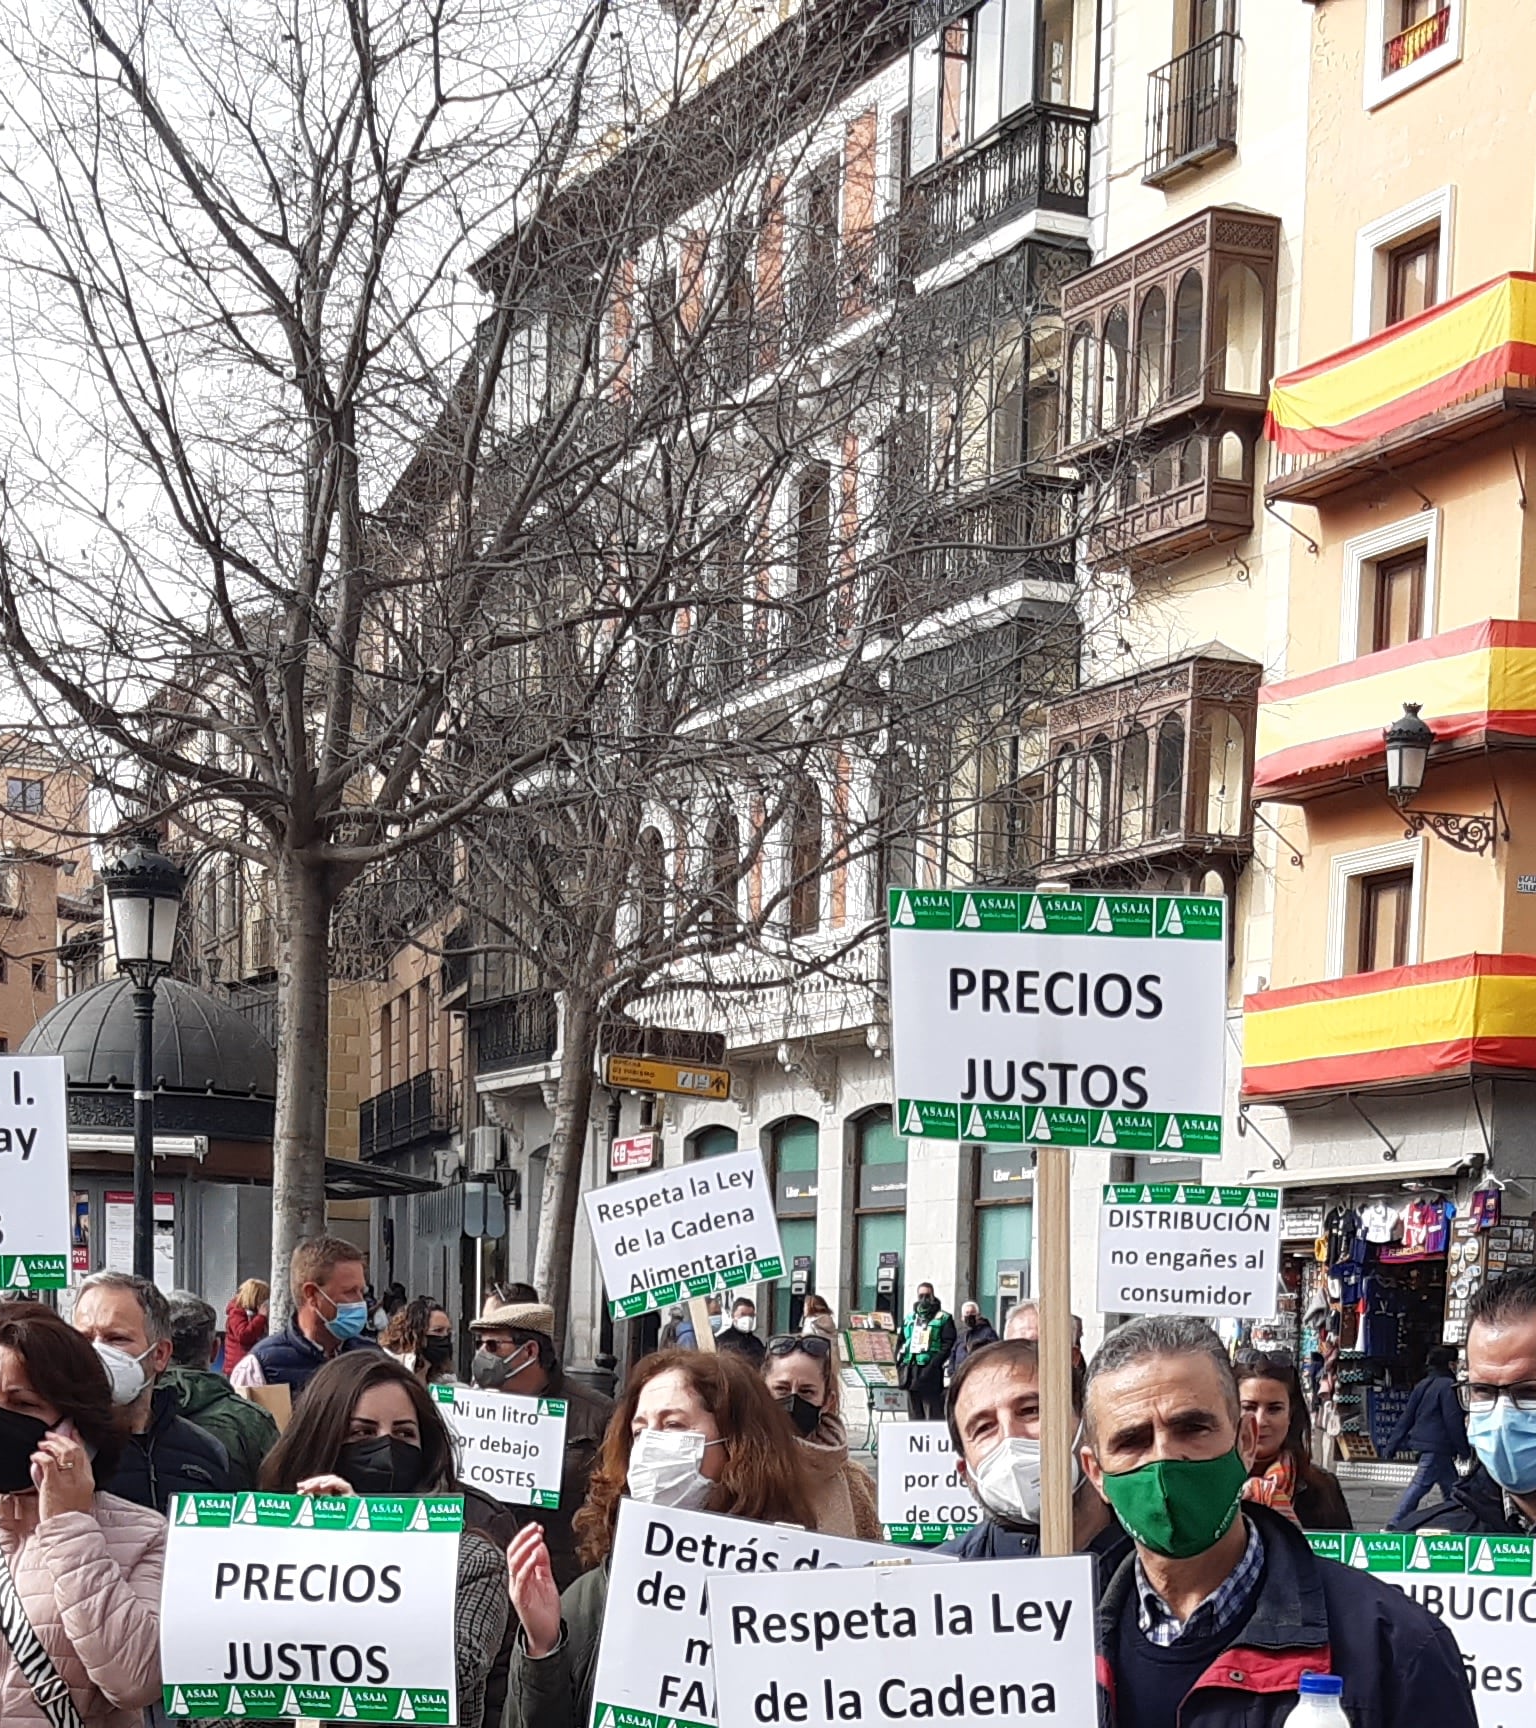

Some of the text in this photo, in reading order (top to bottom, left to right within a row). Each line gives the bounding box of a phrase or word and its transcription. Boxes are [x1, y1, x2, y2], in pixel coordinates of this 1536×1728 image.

[949, 967, 1163, 1020] PRECIOS
[14, 1071, 34, 1105] l.
[960, 1058, 1148, 1111] JUSTOS
[597, 1169, 754, 1222] Respeta la Ley
[615, 1207, 755, 1256] de la Cadena
[1108, 1205, 1270, 1232] DISTRIBUCIÓN
[630, 1244, 757, 1293] Alimentaria
[1112, 1249, 1264, 1271] no engañes al
[1120, 1286, 1252, 1305] consumidor
[452, 1401, 539, 1425] Ni un litro
[480, 1435, 540, 1459] debajo
[910, 1435, 930, 1452] Ni
[471, 1465, 536, 1488] COSTES
[904, 1474, 939, 1492] por
[906, 1505, 930, 1522] de
[645, 1521, 779, 1576] Detrás
[214, 1562, 402, 1603] PRECIOS
[637, 1571, 685, 1612] de
[731, 1592, 1072, 1651] Respeta la Ley
[224, 1642, 390, 1684] JUSTOS
[753, 1680, 808, 1723] de
[824, 1679, 862, 1721] la
[879, 1674, 1056, 1720] Cadena
